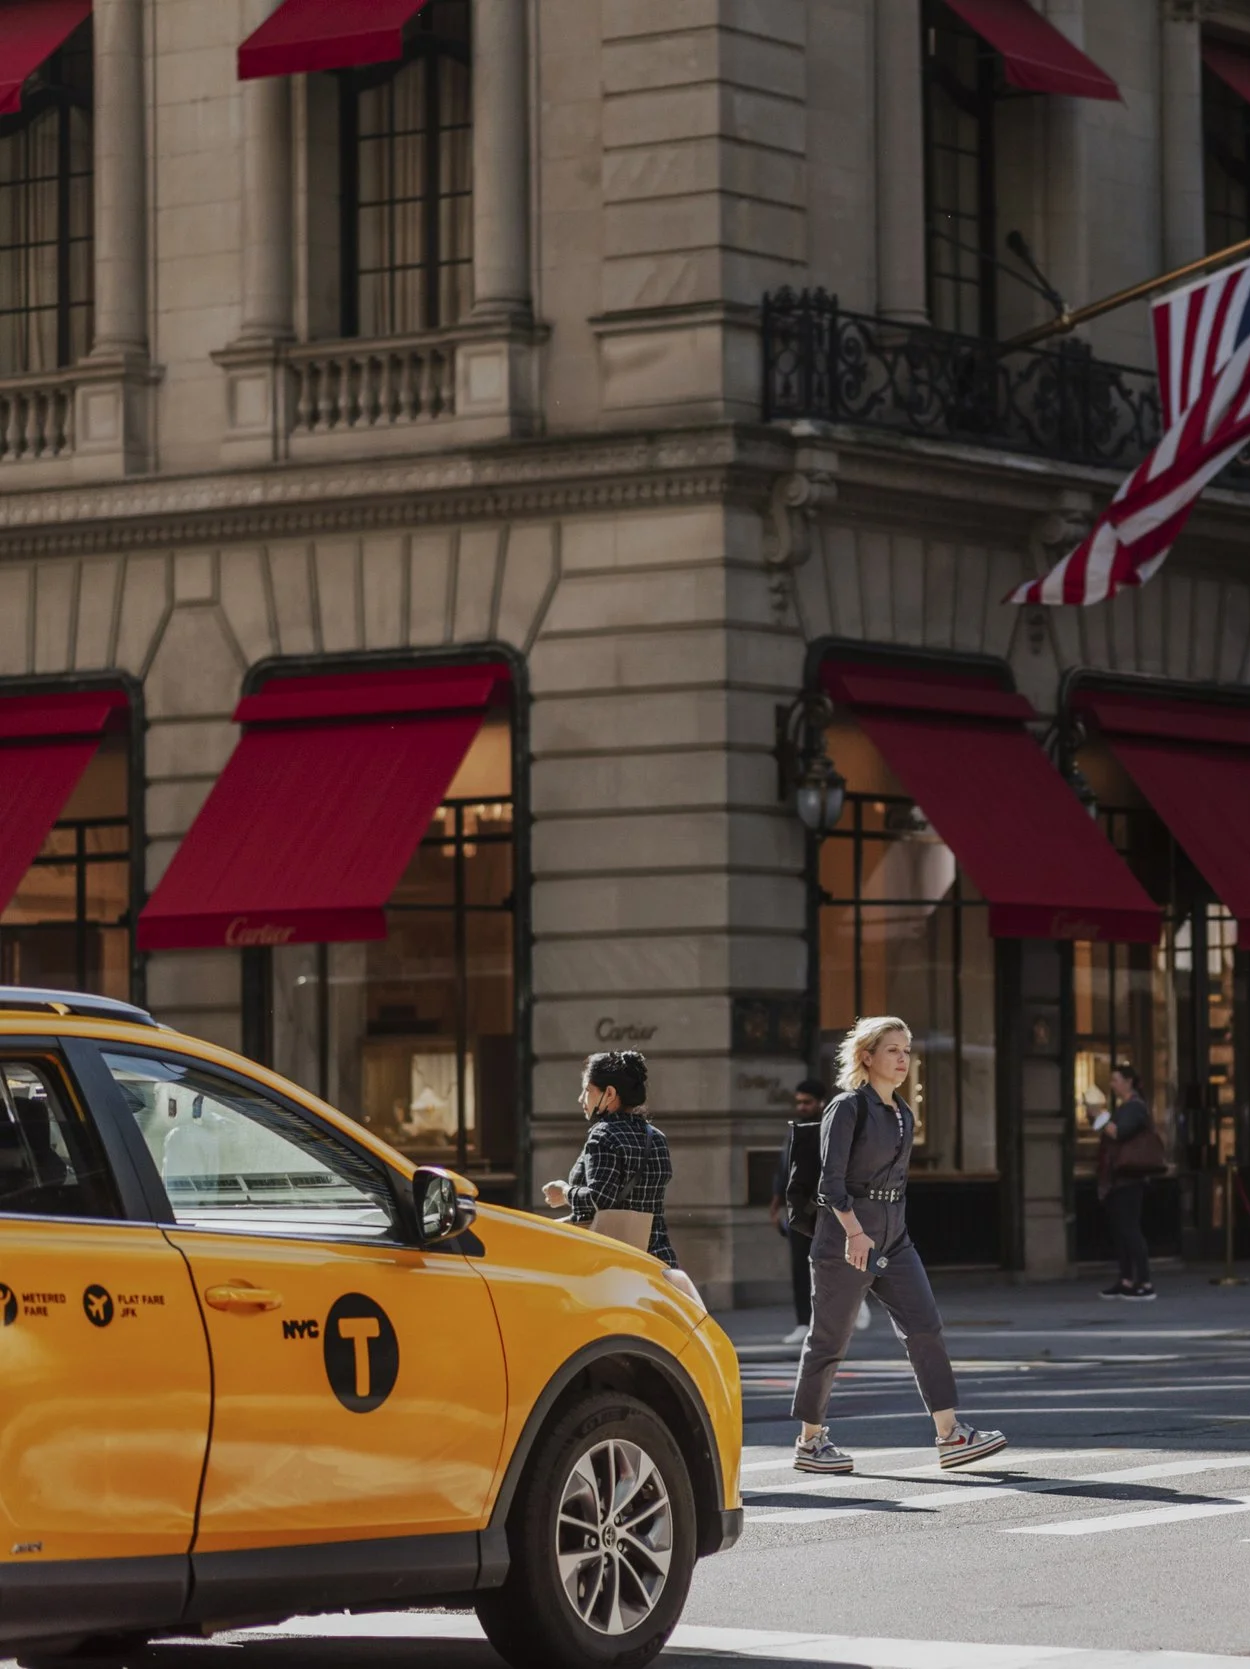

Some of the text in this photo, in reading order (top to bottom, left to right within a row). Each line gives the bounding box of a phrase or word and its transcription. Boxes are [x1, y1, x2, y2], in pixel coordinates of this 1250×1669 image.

[225, 916, 297, 946] Cartier
[594, 1017, 659, 1042] Cartier
[22, 1292, 67, 1304] METERED
[117, 1294, 166, 1306] FLAT FARE
[24, 1306, 49, 1317] FARE
[120, 1308, 138, 1318] JFK
[282, 1316, 380, 1398] NYC T
